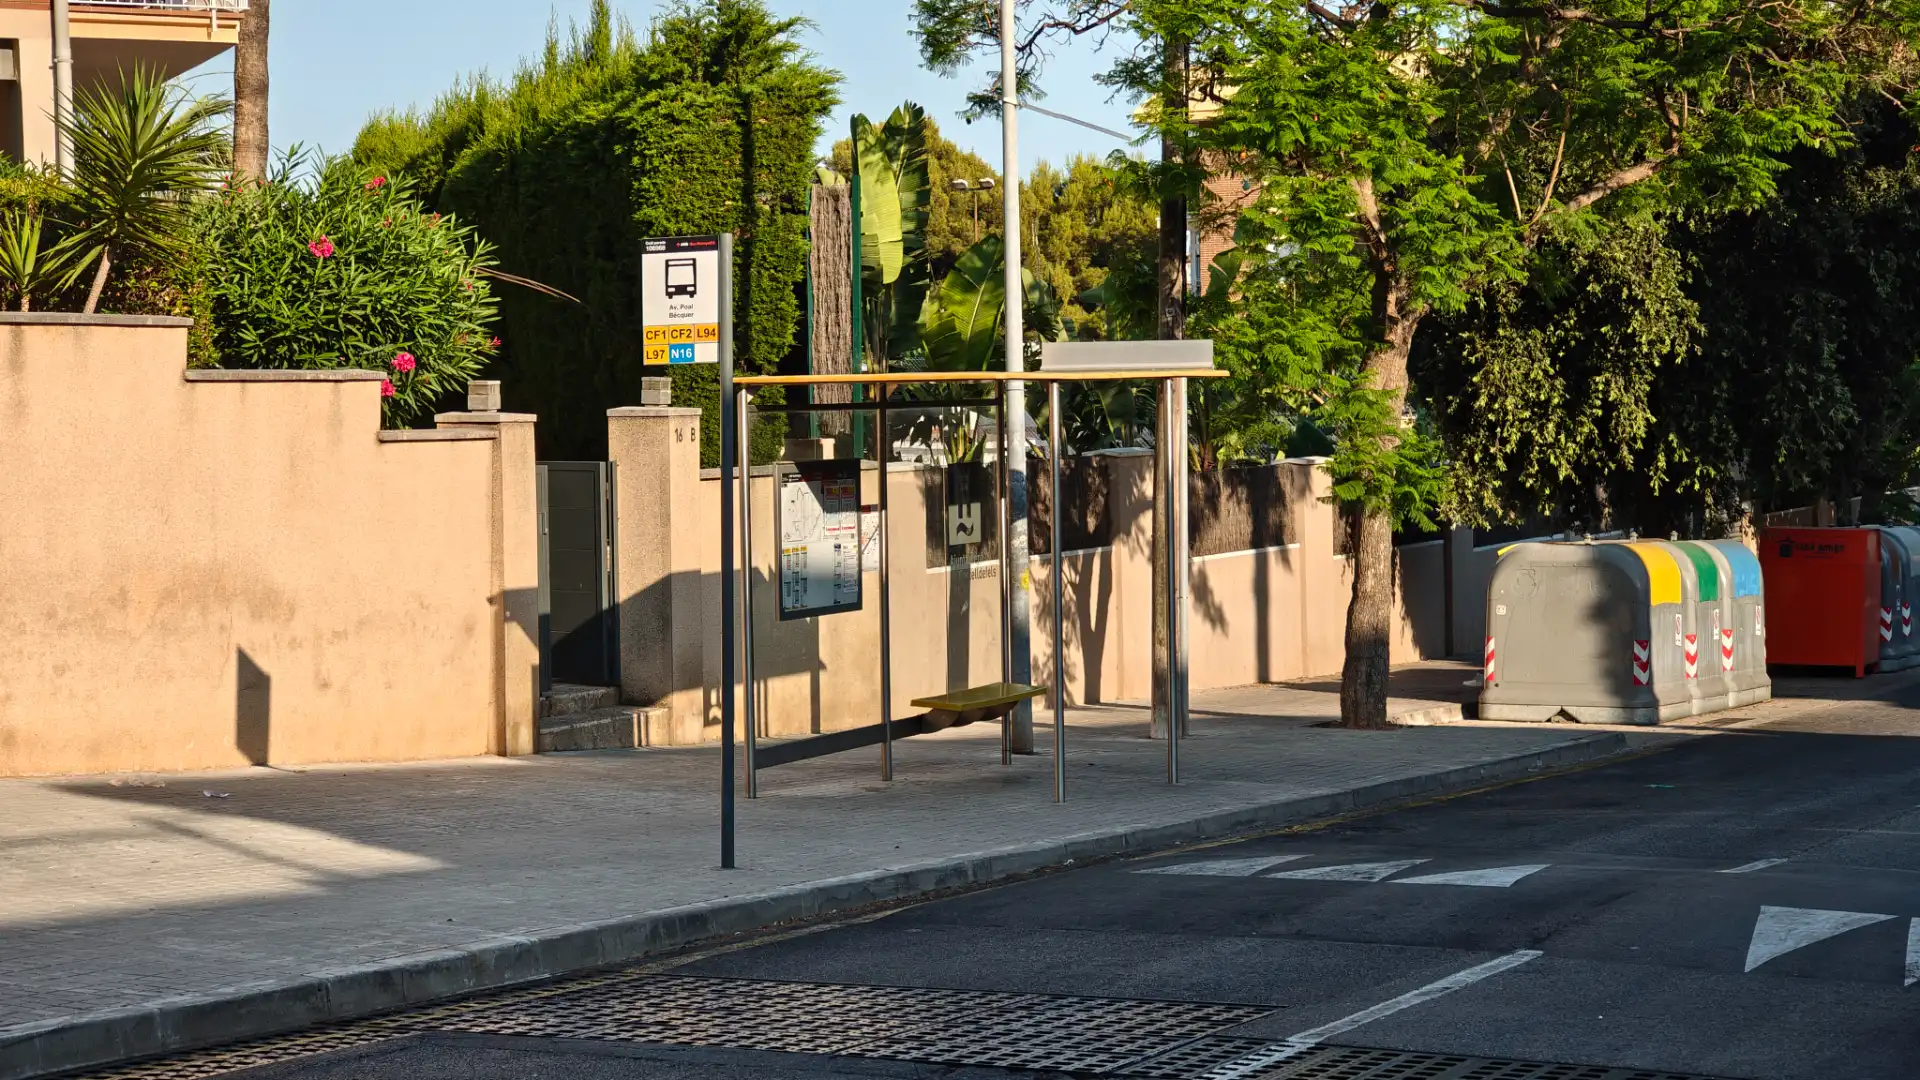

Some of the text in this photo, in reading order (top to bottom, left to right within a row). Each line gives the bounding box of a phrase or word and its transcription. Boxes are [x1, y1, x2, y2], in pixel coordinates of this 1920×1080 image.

[646, 328, 716, 340] CF1 CF2 L94
[646, 348, 692, 360] L97 N16
[674, 427, 697, 443] 16 B
